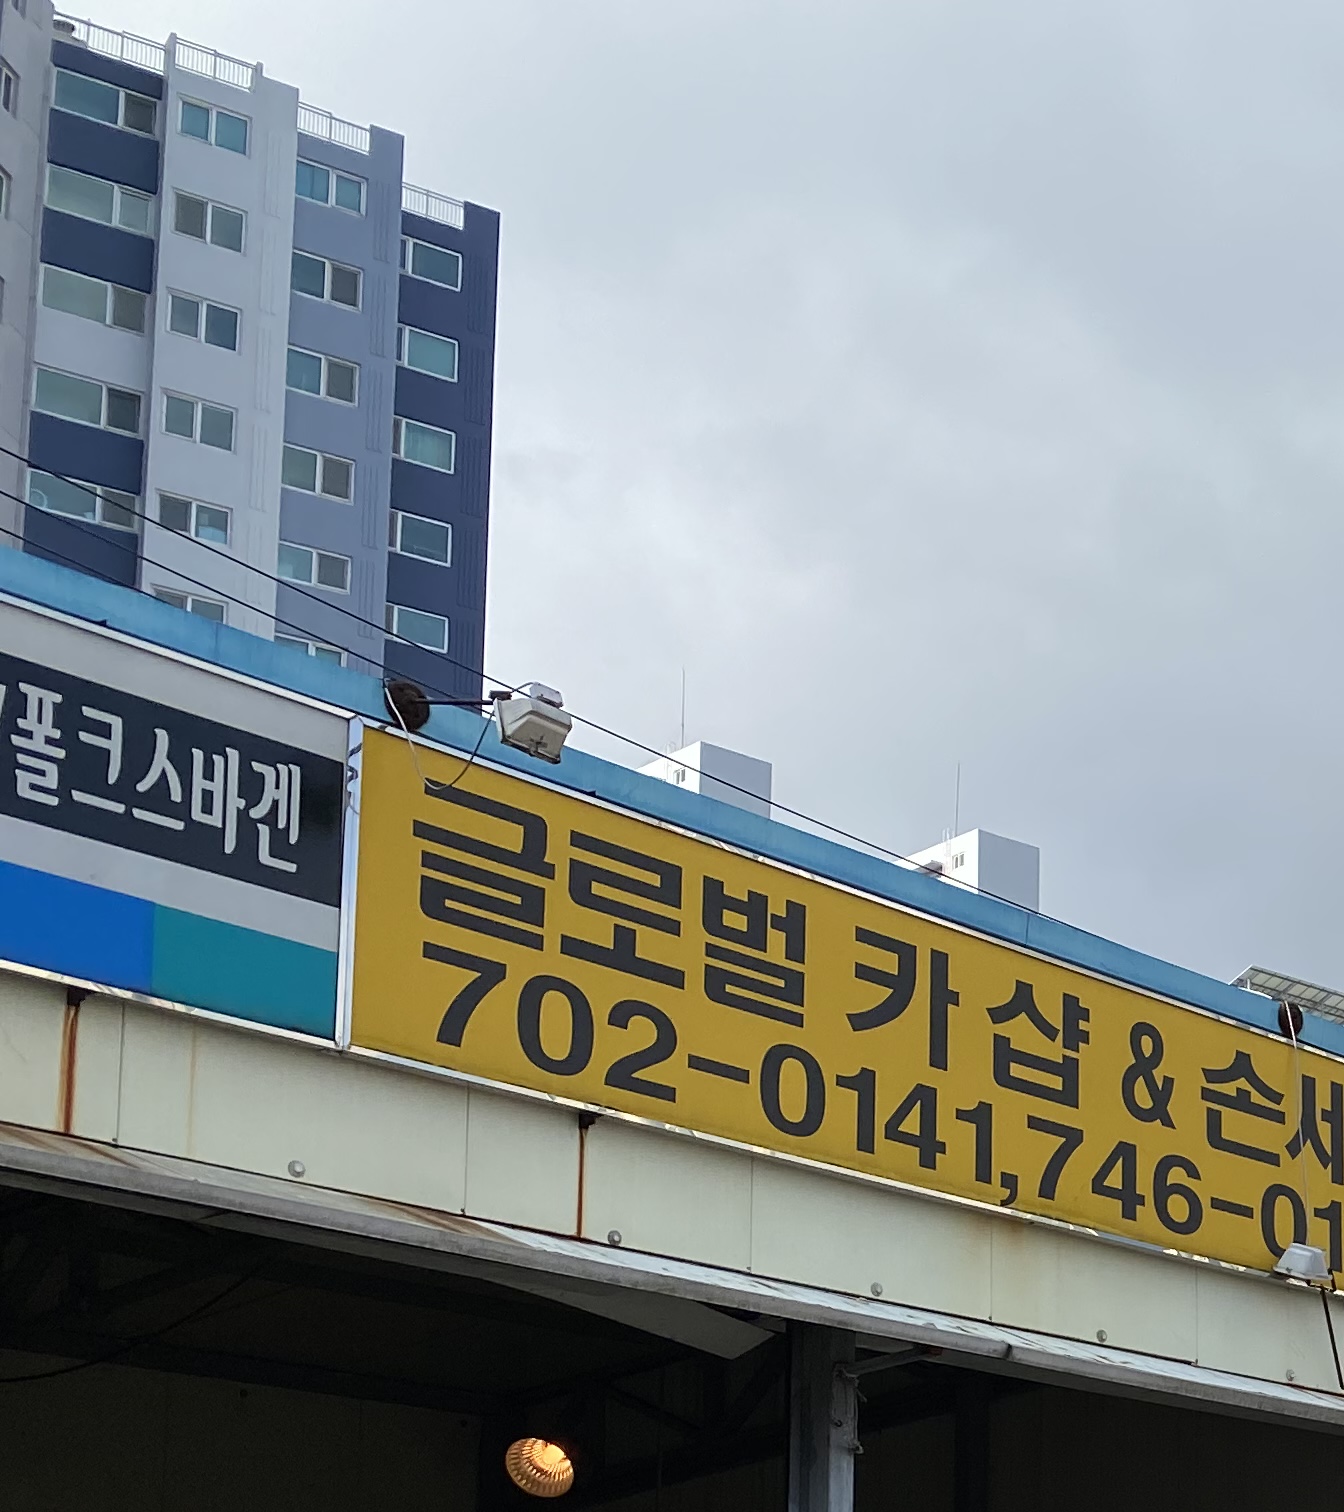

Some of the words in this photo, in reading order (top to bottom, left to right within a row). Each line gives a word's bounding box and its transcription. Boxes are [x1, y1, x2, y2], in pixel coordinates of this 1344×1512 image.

[0, 681, 303, 874] 폴크스바겐
[412, 778, 807, 1029] 글로벌
[1121, 1021, 1177, 1130] &
